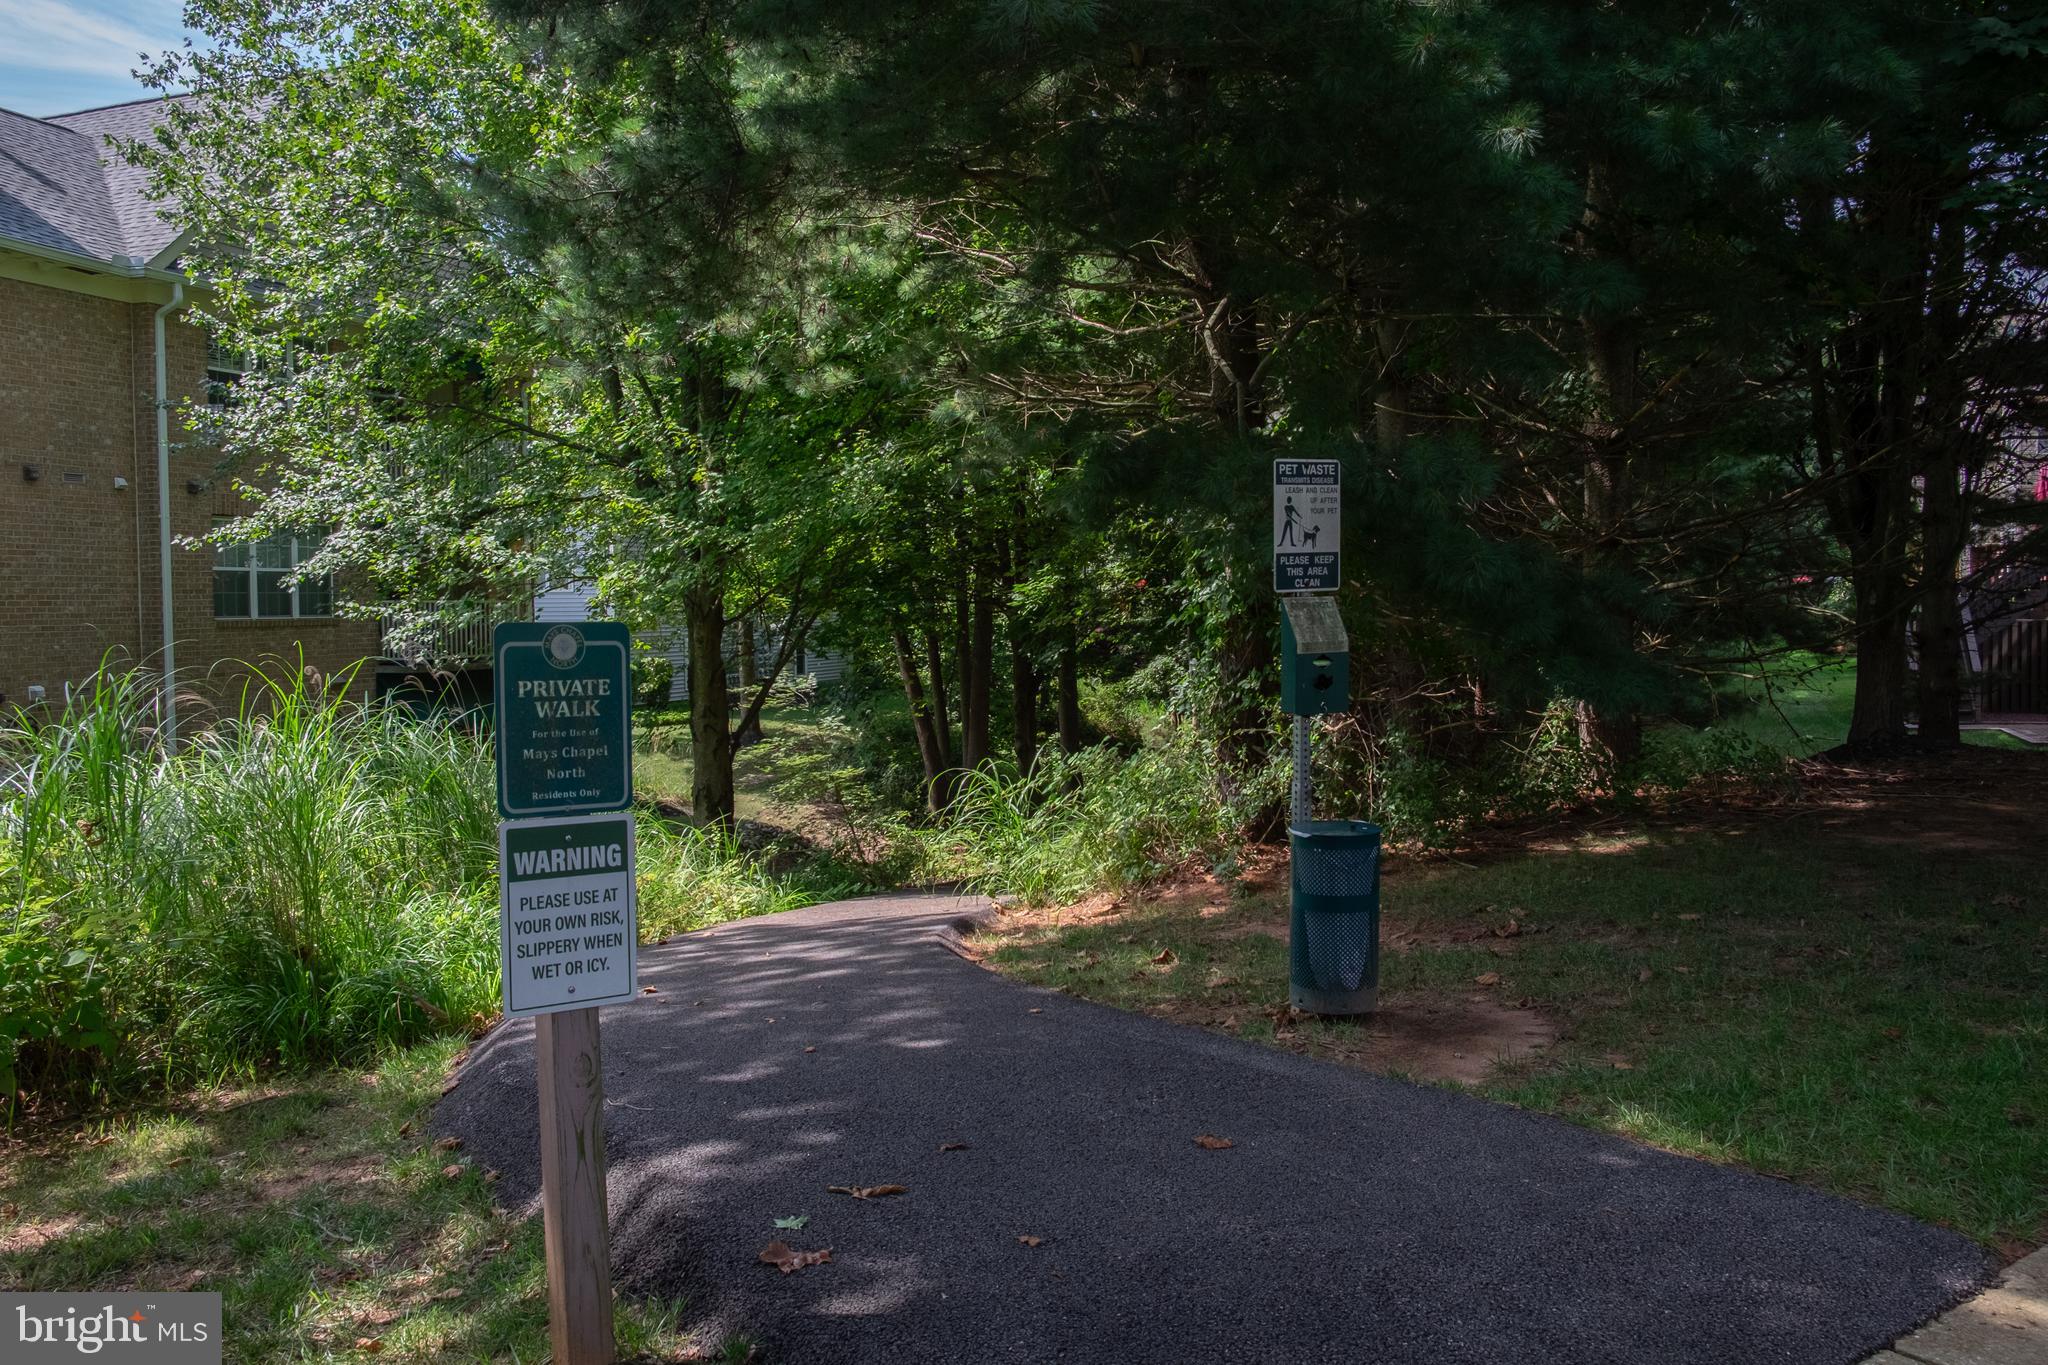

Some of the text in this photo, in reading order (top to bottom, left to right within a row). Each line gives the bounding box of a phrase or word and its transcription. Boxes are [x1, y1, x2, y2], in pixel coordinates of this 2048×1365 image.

[1279, 464, 1336, 475] PET WASTE
[1280, 555, 1334, 565] PLEASE KEEP
[1308, 567, 1328, 575] AREA
[517, 679, 611, 698] PRIVATE
[533, 700, 601, 719] WALK
[523, 745, 608, 761] Mays Chapel
[547, 767, 585, 779] North
[532, 789, 601, 800] Residents Only
[513, 844, 622, 876] WARNING
[520, 888, 618, 911] PLEASE USE AT
[514, 911, 624, 935] YOUR OWN RISK,
[517, 933, 623, 959] SLIPPERY WHEN
[532, 957, 610, 980] WET OR ICY.
